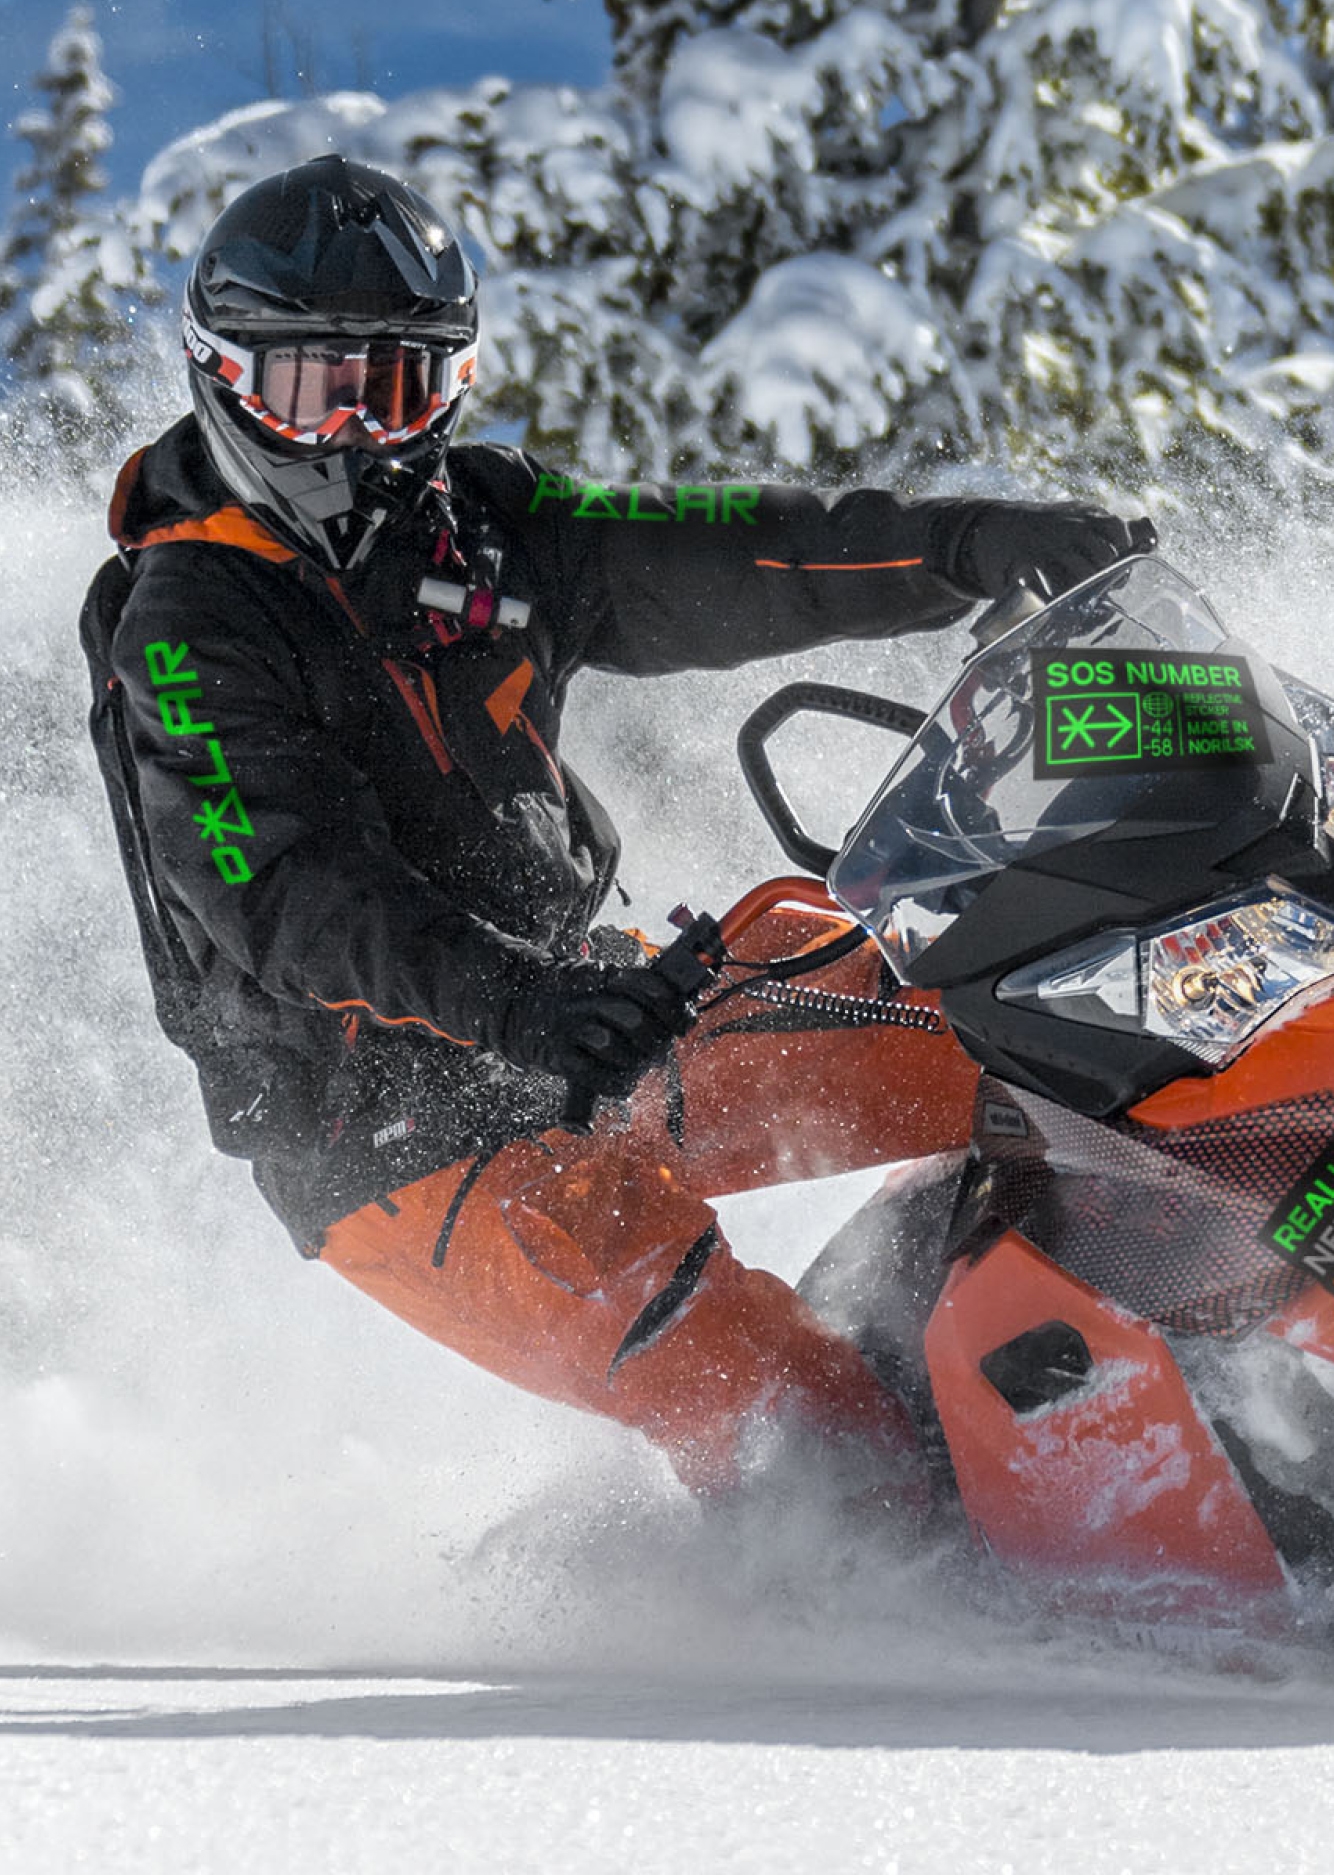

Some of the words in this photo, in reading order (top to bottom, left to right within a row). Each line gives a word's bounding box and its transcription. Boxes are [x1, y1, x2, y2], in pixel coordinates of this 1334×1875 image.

[1046, 661, 1116, 688] SOS
[1126, 661, 1242, 688] NUMBER
[1142, 719, 1174, 736] -44
[1187, 720, 1230, 735] MADE
[1232, 720, 1249, 734] IN
[1142, 738, 1174, 757] -58
[1188, 736, 1255, 755] NORILSK
